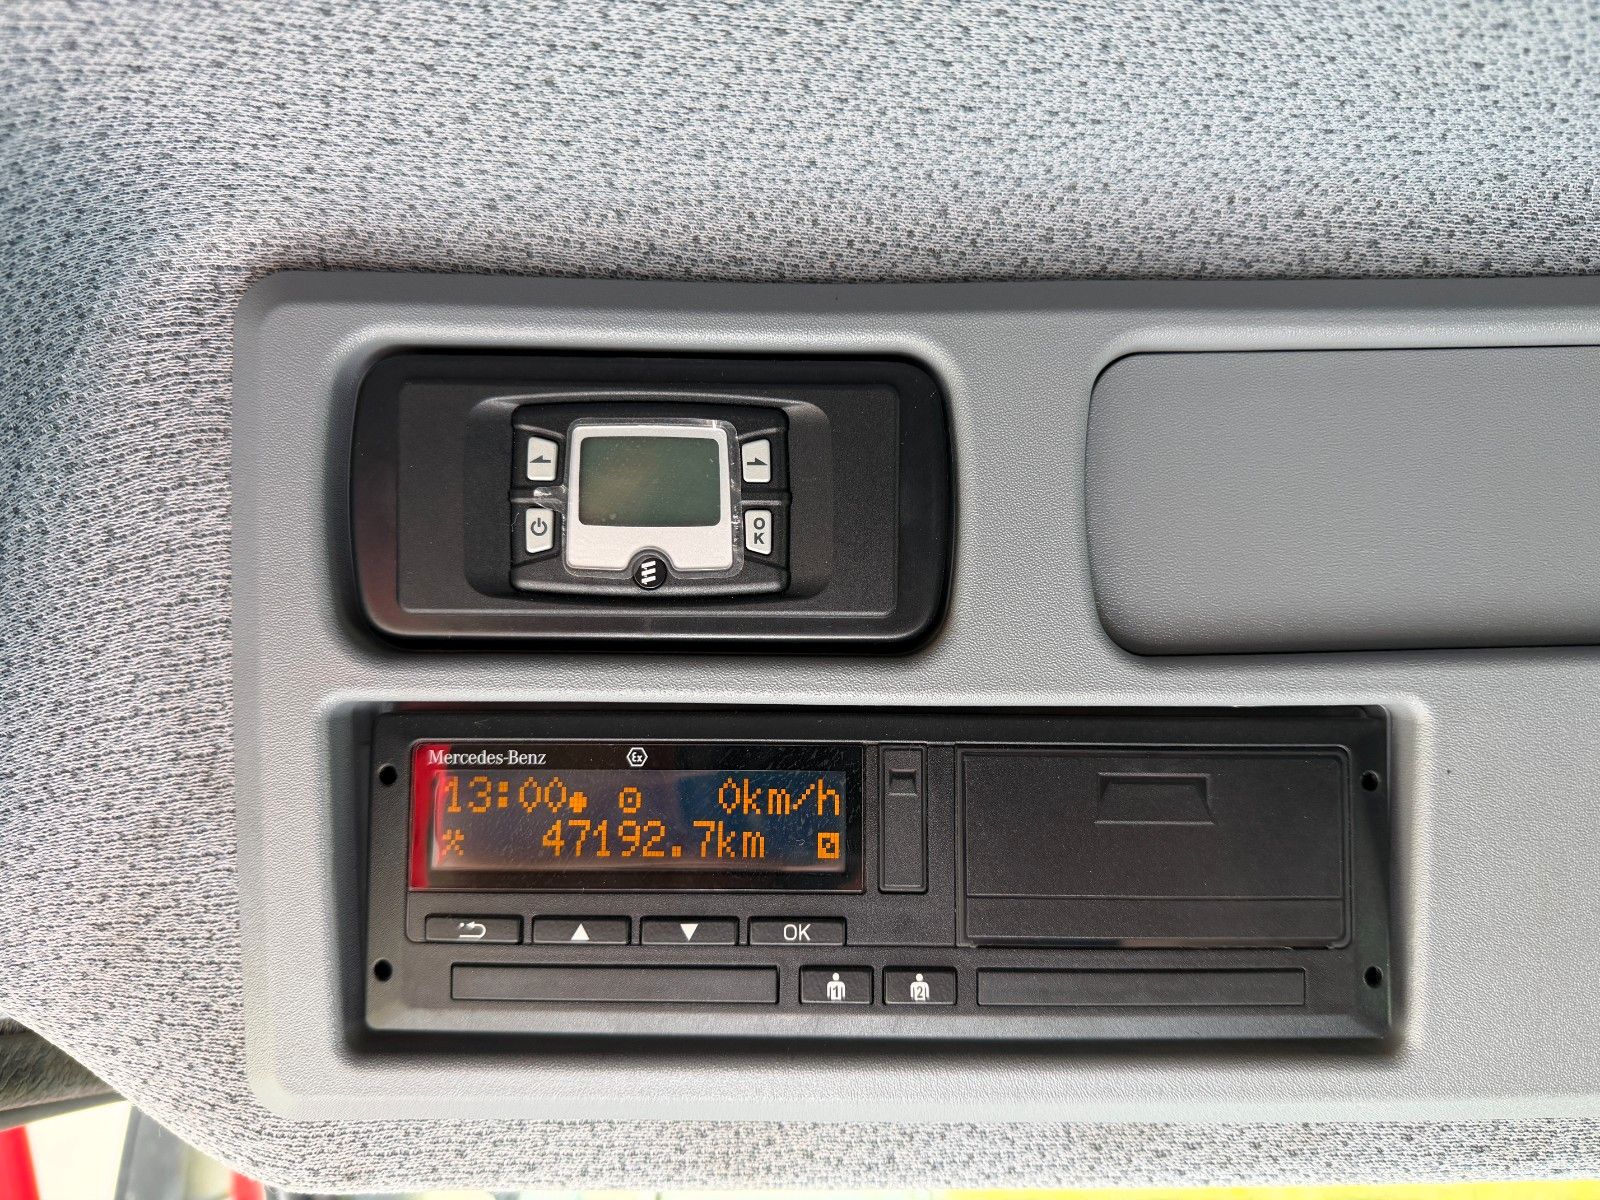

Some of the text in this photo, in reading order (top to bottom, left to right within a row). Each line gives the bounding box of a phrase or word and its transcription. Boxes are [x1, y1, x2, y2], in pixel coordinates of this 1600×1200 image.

[753, 517, 766, 545] OK
[428, 749, 547, 766] Mercedes-Benz
[444, 775, 567, 814] 13:00
[718, 777, 840, 816] 0km/h
[541, 819, 765, 859] 47192.7km
[783, 923, 812, 941] OK
[916, 985, 923, 998] 2
